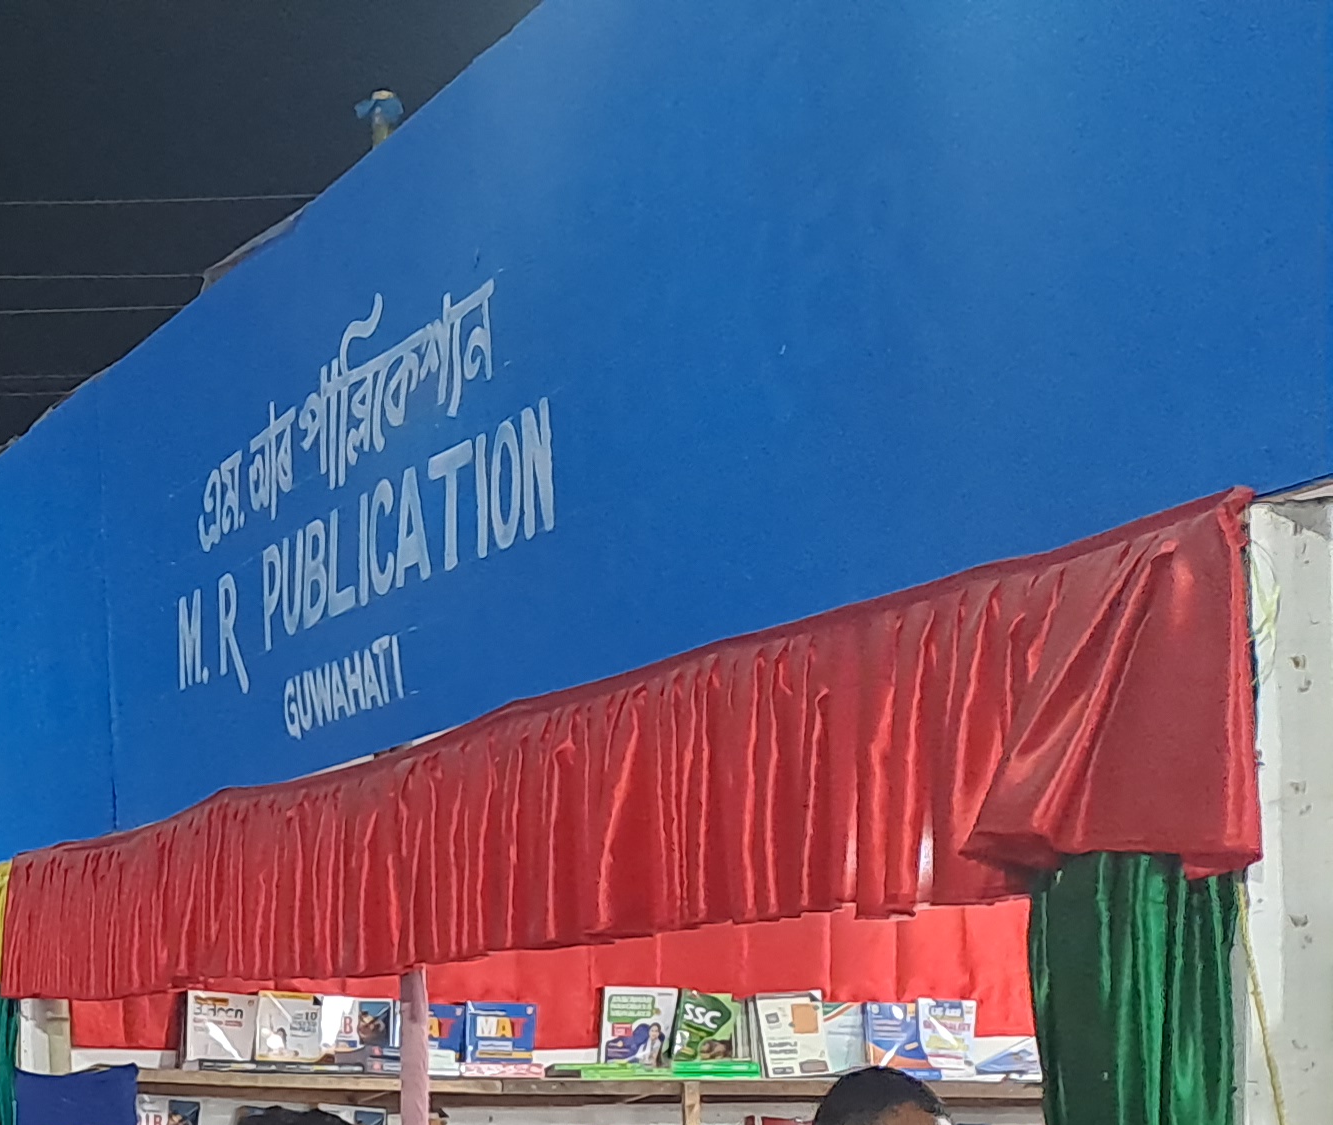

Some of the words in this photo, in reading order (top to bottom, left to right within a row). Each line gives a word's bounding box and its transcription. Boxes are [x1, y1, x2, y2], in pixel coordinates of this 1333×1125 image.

[262, 397, 554, 651] PUBLICATION
[284, 634, 405, 740] GUWAHATI
[475, 1016, 528, 1038] MAT
[683, 1003, 722, 1029] SSC
